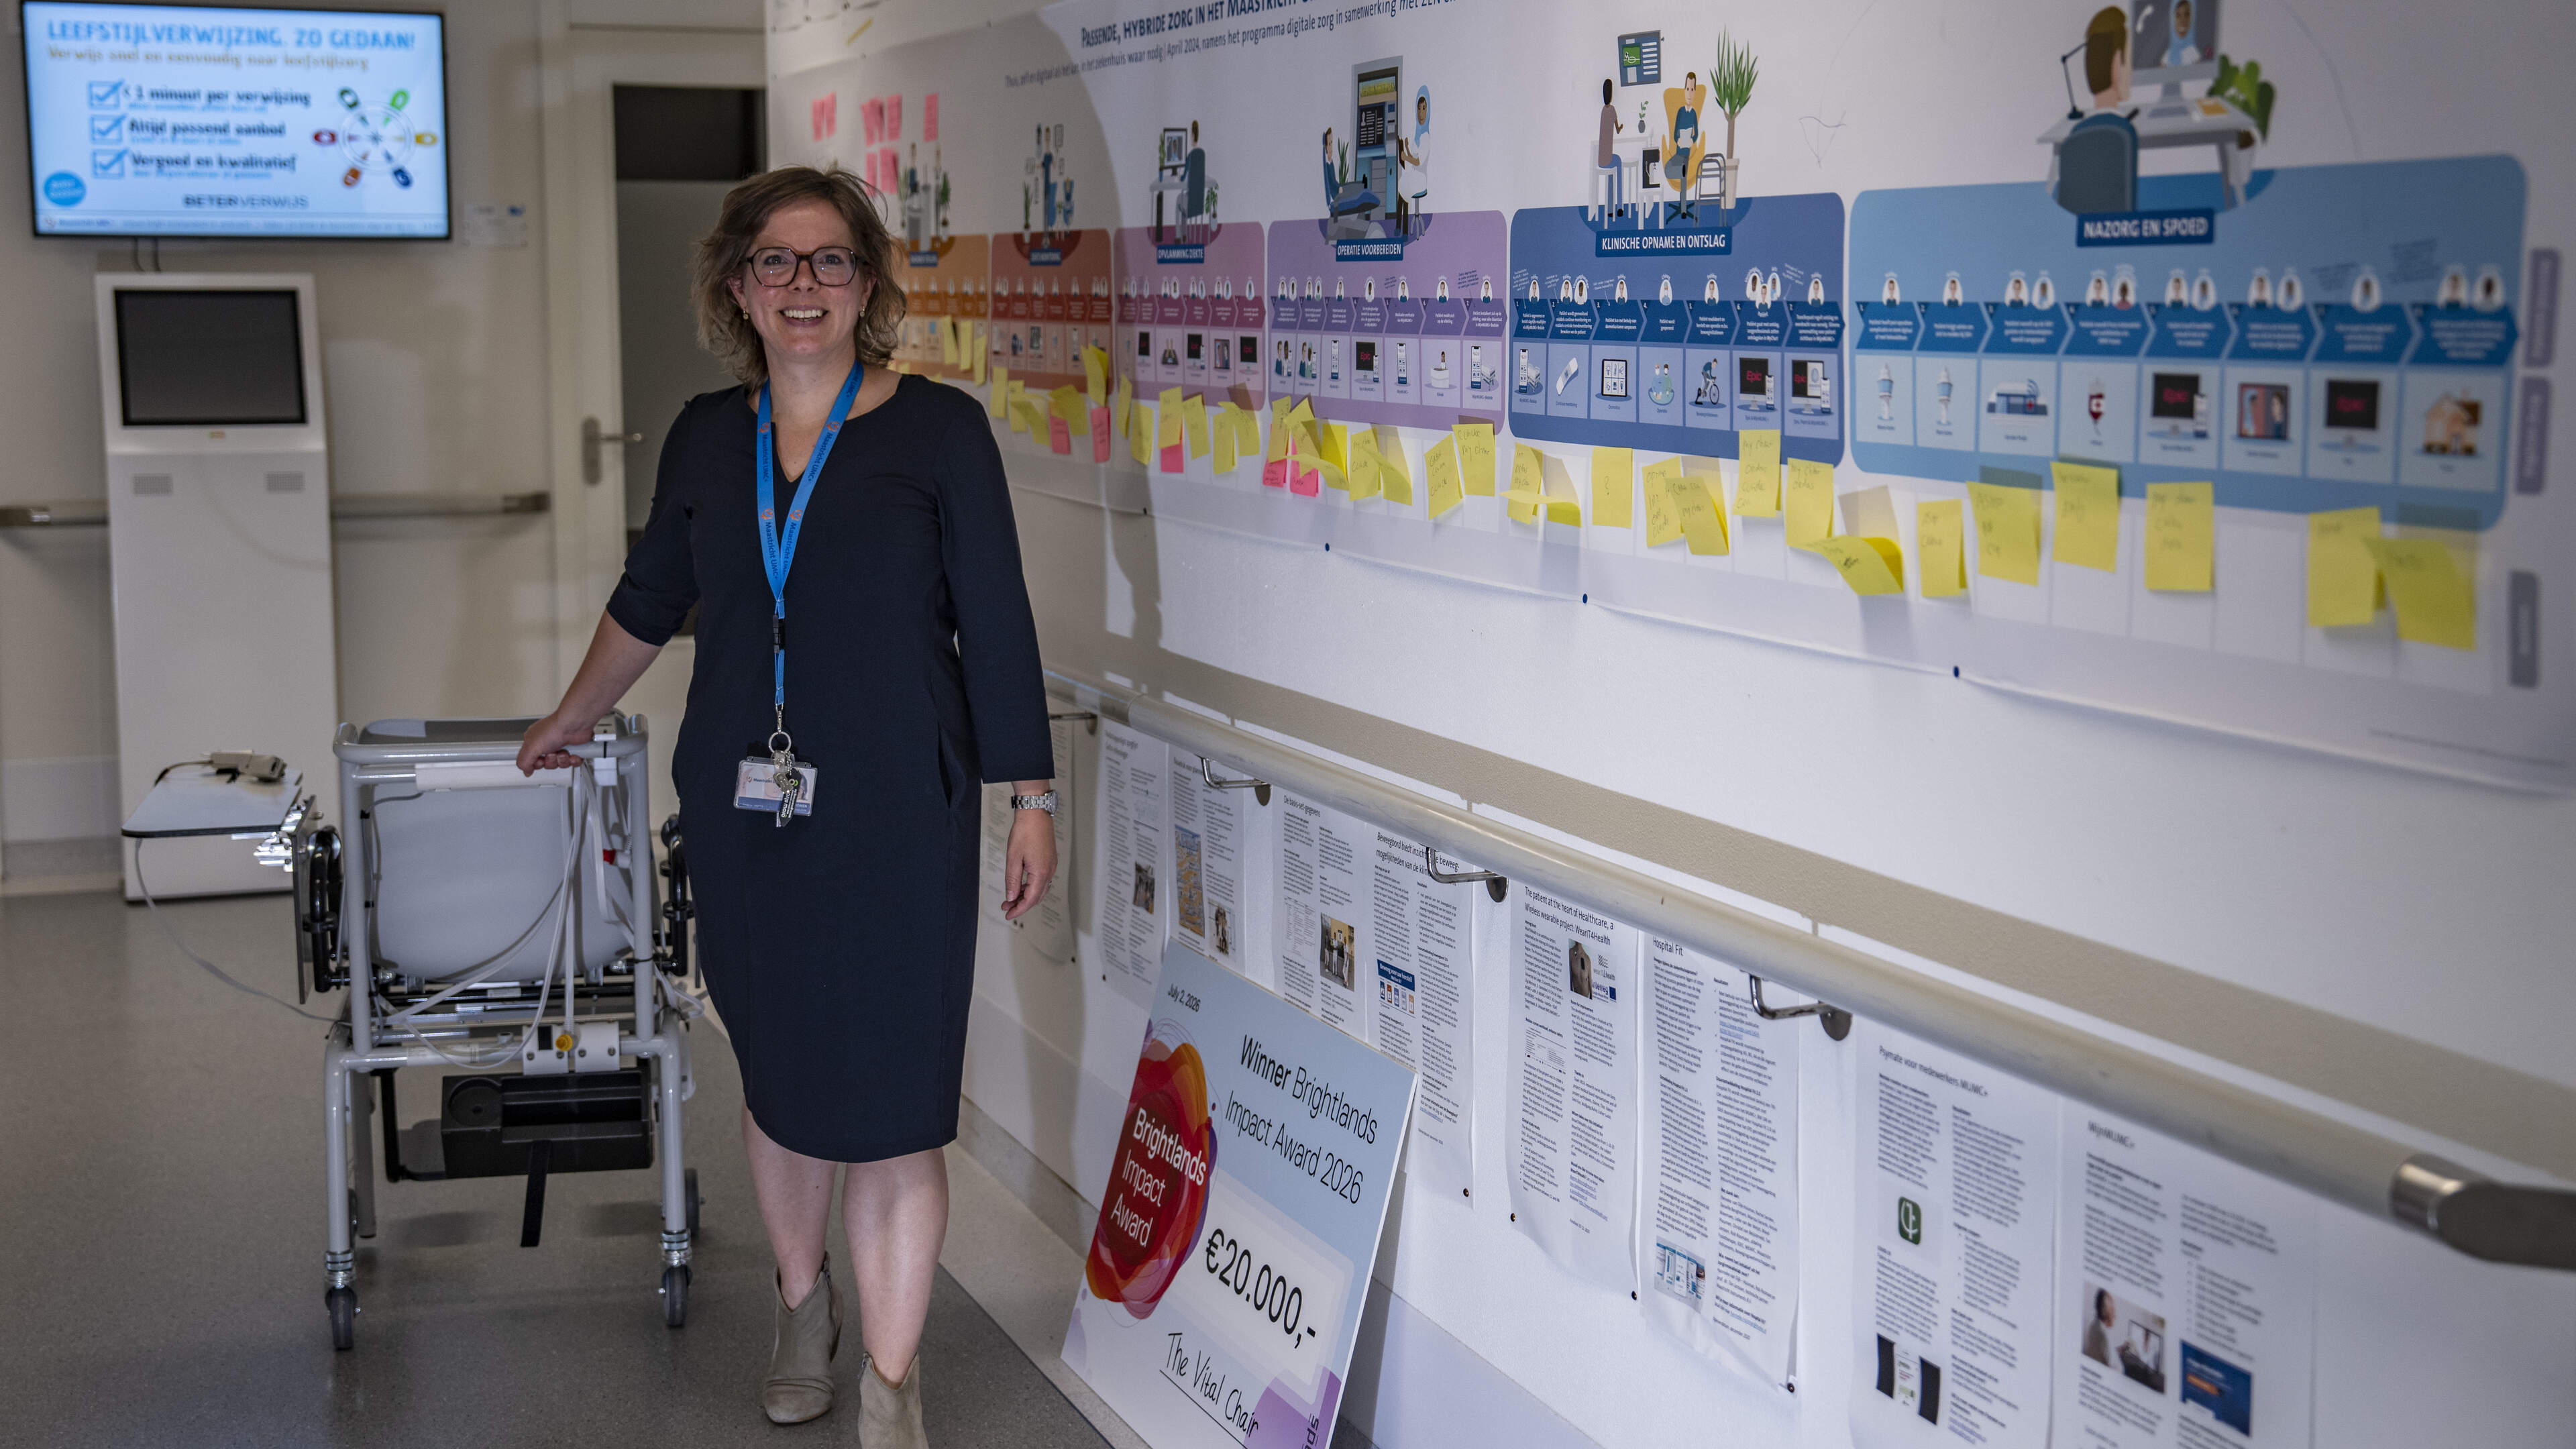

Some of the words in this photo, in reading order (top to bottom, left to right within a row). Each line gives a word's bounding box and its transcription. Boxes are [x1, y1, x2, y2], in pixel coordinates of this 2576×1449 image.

[1123, 13, 1166, 39] HYBRIDE
[1168, 9, 1193, 32] ZORG
[1195, 5, 1205, 25] IN
[1207, 0, 1224, 21] HET
[1128, 50, 1145, 63] waar
[1147, 43, 1164, 62] nodig
[1167, 38, 1183, 59] April
[1185, 36, 1201, 54] 2024,
[1202, 32, 1226, 50] namens
[1228, 29, 1240, 45] het
[1242, 23, 1285, 47] programma
[1287, 13, 1316, 38] digitale
[1318, 11, 1334, 32] zorg
[1336, 9, 1342, 25] in
[1345, 0, 1395, 23] samenwerking
[295, 28, 322, 48] ZO
[329, 30, 415, 50] GEDAAN!
[109, 50, 140, 62] snel
[144, 52, 162, 62] en
[167, 51, 241, 66] eenvoudig
[248, 54, 277, 65] naar
[150, 86, 201, 101] minuut
[207, 89, 229, 105] per
[237, 88, 311, 108] verwijzing
[129, 119, 166, 136] Altijd
[171, 120, 231, 140] passend
[235, 121, 286, 136] aanbod
[131, 152, 191, 173] Vergoed
[195, 157, 213, 168] en
[218, 153, 297, 173] kwalitatief
[183, 194, 309, 209] BETERVERWIJS
[1602, 237, 1640, 250] KLINISCHE
[1642, 235, 1675, 250] OPNAME
[1676, 235, 1686, 249] EN
[1688, 233, 1726, 248] ONTSLAG
[2084, 219, 2140, 238] NAZORG
[2142, 219, 2161, 237] EN
[2162, 217, 2208, 236] SPOED
[1159, 249, 1189, 259] OPVLAMMING
[1189, 248, 1203, 258] ZIEKTE
[1338, 245, 1360, 256] OPERATIE
[1361, 244, 1401, 255] VOORBEREIDEN
[1360, 351, 1371, 360] Epic
[1746, 370, 1762, 383] Epic
[814, 431, 833, 464] Maastricht
[807, 462, 820, 482] UMC+
[765, 521, 775, 555] Maastricht
[784, 522, 797, 556] Maastricht
[769, 553, 779, 580] UMC+
[1284, 795, 1289, 806] De
[1376, 848, 1405, 869] mogelijkheden
[1405, 859, 1413, 871] van
[1413, 861, 1419, 873] de
[1377, 832, 1401, 850] Beweegbord
[1401, 841, 1412, 855] biedt
[1440, 857, 1460, 872] beweeg-
[1525, 902, 1541, 917] Wireless
[1541, 911, 1559, 925] wearable
[1559, 920, 1575, 932] project:
[1575, 924, 1611, 946] WearIT4Health
[1533, 892, 1548, 905] patient
[1548, 898, 1553, 906] at
[1553, 899, 1561, 910] the
[1561, 902, 1573, 916] heart
[1573, 908, 1578, 918] of
[1578, 911, 1609, 930] Healthcare,
[1610, 922, 1614, 930] a
[1653, 935, 1674, 953] Hospital
[1675, 944, 1684, 957] Fit
[1167, 983, 1180, 1002] July
[1179, 989, 1185, 1006] 2,
[1185, 993, 1201, 1012] 2026
[1879, 1045, 1903, 1064] Psymate
[1903, 1057, 1918, 1069] voor
[1919, 1063, 1959, 1087] medewerkers
[1960, 1077, 1988, 1097] MUMC+
[1240, 1034, 1292, 1090] Winner
[1292, 1066, 1378, 1144] Brightlands
[1132, 1107, 1208, 1186] Brightlands
[1226, 1090, 1273, 1146] Impact
[1273, 1122, 1322, 1177] Award
[1320, 1151, 1364, 1205] 2026
[1122, 1149, 1166, 1208] Impact
[1110, 1193, 1154, 1248] Award
[1205, 1228, 1317, 1350] €20.000,-
[1167, 1332, 1189, 1377] The
[1194, 1349, 1226, 1405] Vital
[1225, 1388, 1260, 1439] Chair
